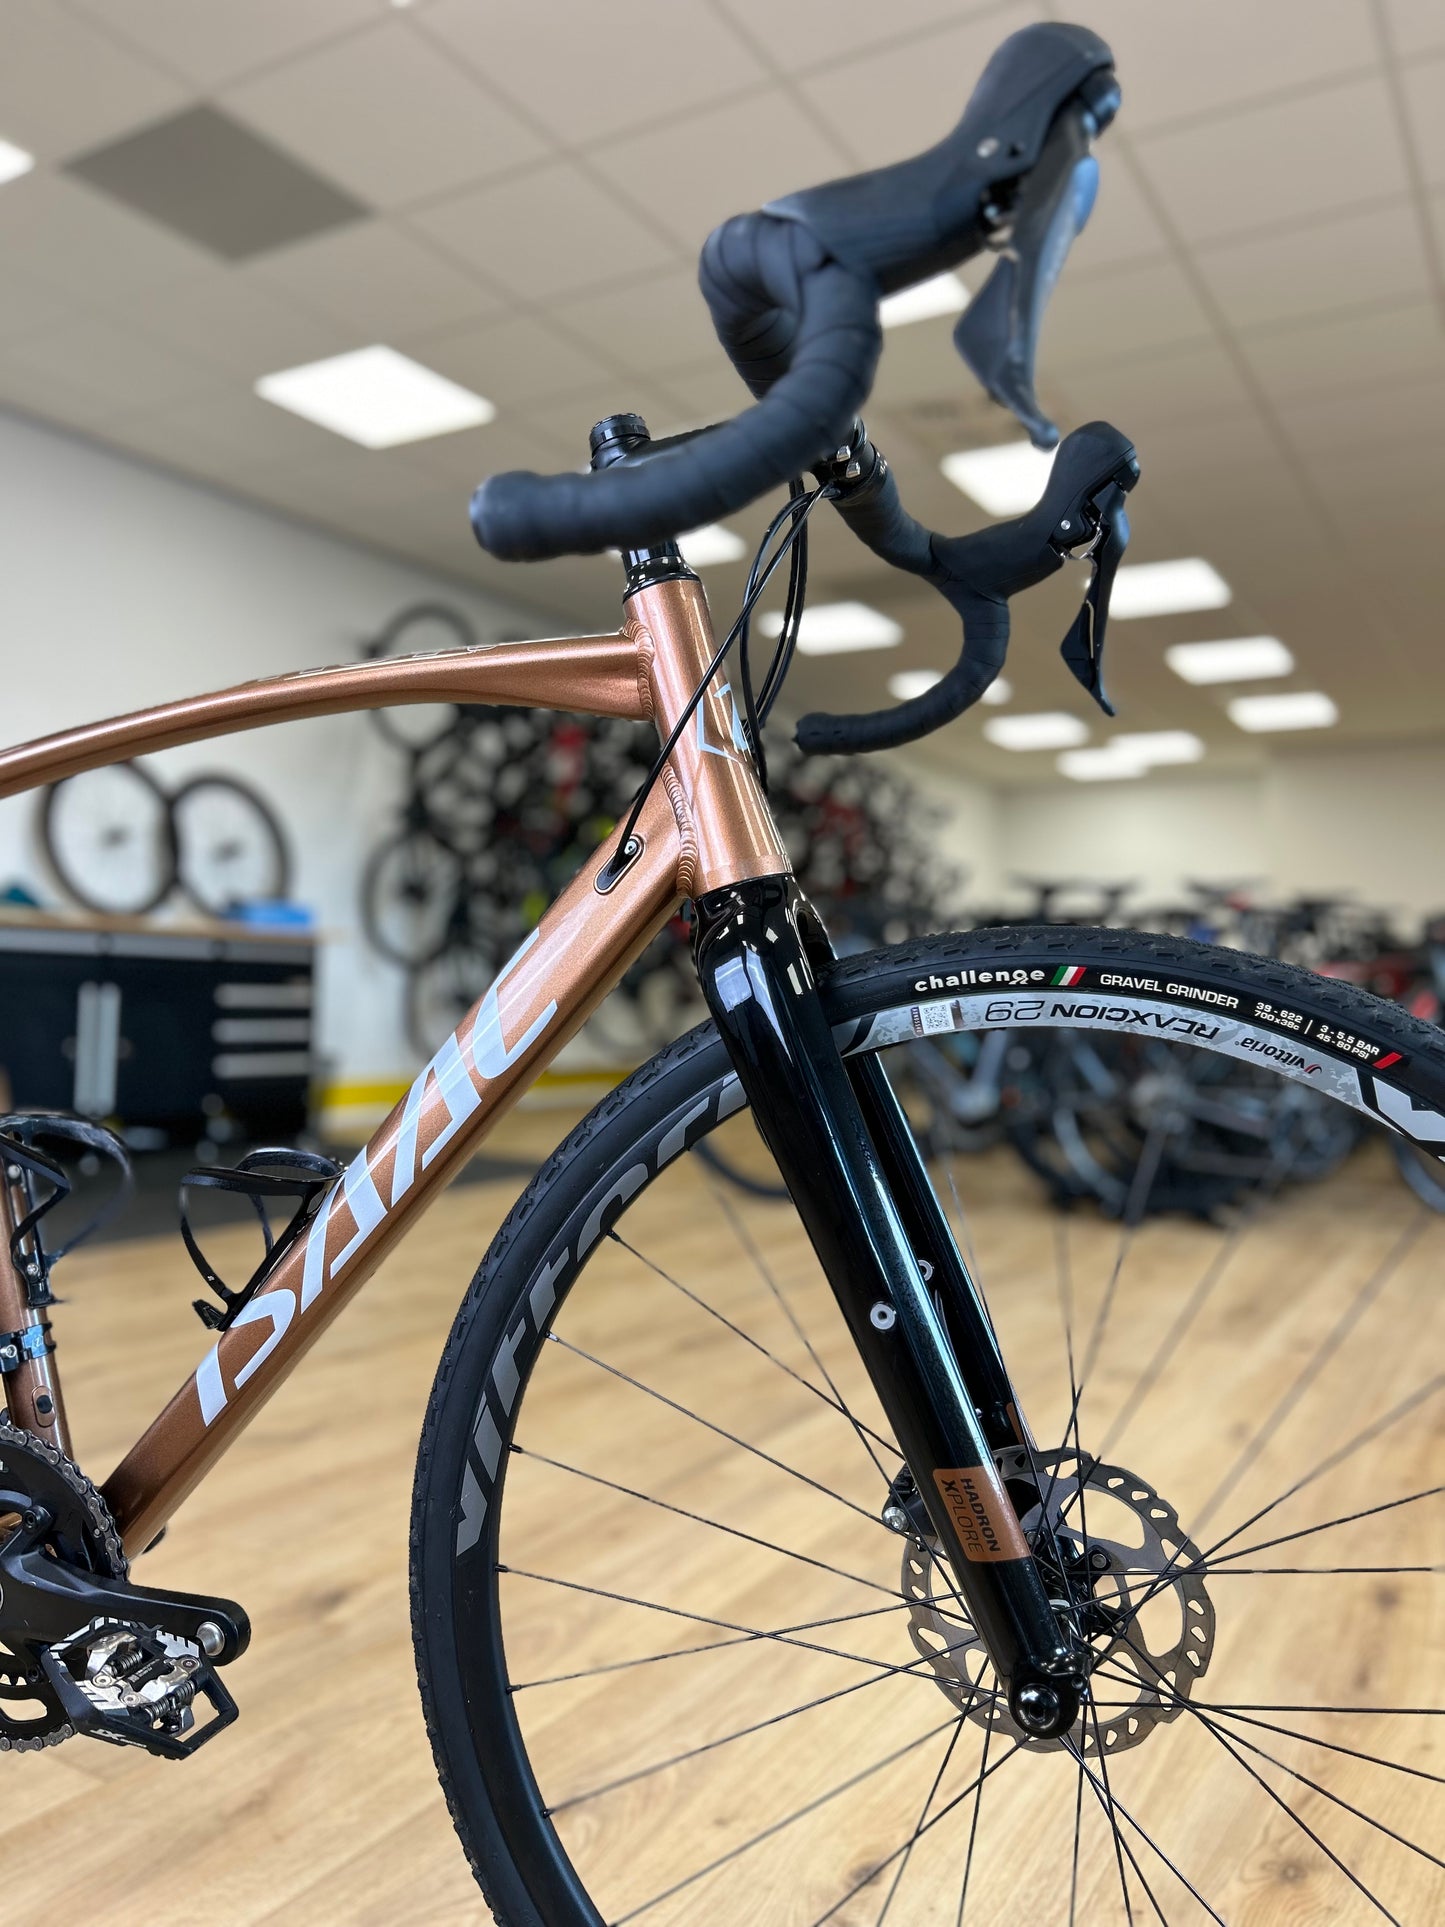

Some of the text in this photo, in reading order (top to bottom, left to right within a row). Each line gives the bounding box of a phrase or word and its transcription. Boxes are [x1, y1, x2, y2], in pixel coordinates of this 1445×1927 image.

[914, 969, 1046, 993] challenge
[1100, 974, 1240, 1010] GRAVEL GRINDER
[985, 1000, 1046, 1022] 29
[1254, 1009, 1301, 1031] 700x38c
[1240, 1037, 1306, 1070] vittoria
[1351, 1046, 1370, 1060] PSI
[1356, 1039, 1380, 1056] BAR
[455, 1070, 748, 1557] vittori
[940, 1479, 985, 1553] XPLORE
[960, 1478, 1001, 1552] HADRON
